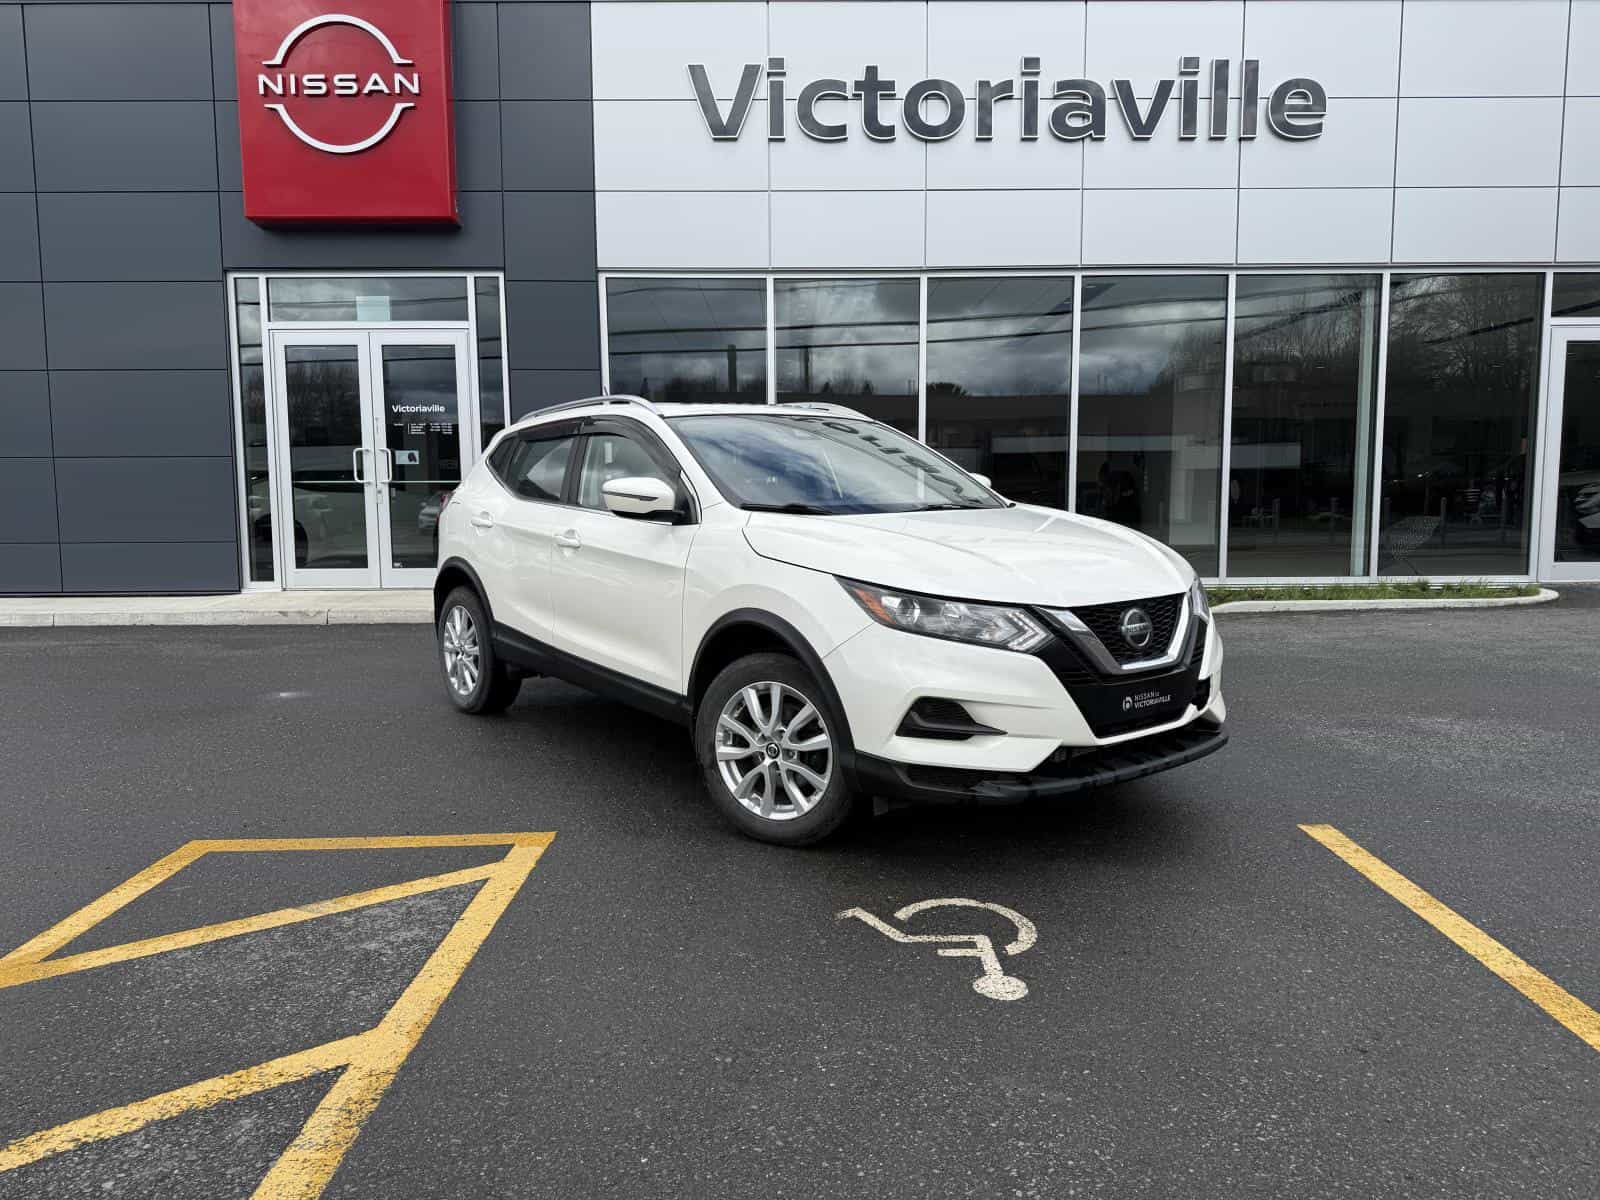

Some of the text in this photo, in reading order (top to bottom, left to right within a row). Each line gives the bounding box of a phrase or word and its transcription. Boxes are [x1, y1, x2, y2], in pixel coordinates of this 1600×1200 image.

[257, 72, 420, 97] NISSAN
[686, 56, 1328, 143] Victoriaville
[392, 404, 446, 413] Victoriaville
